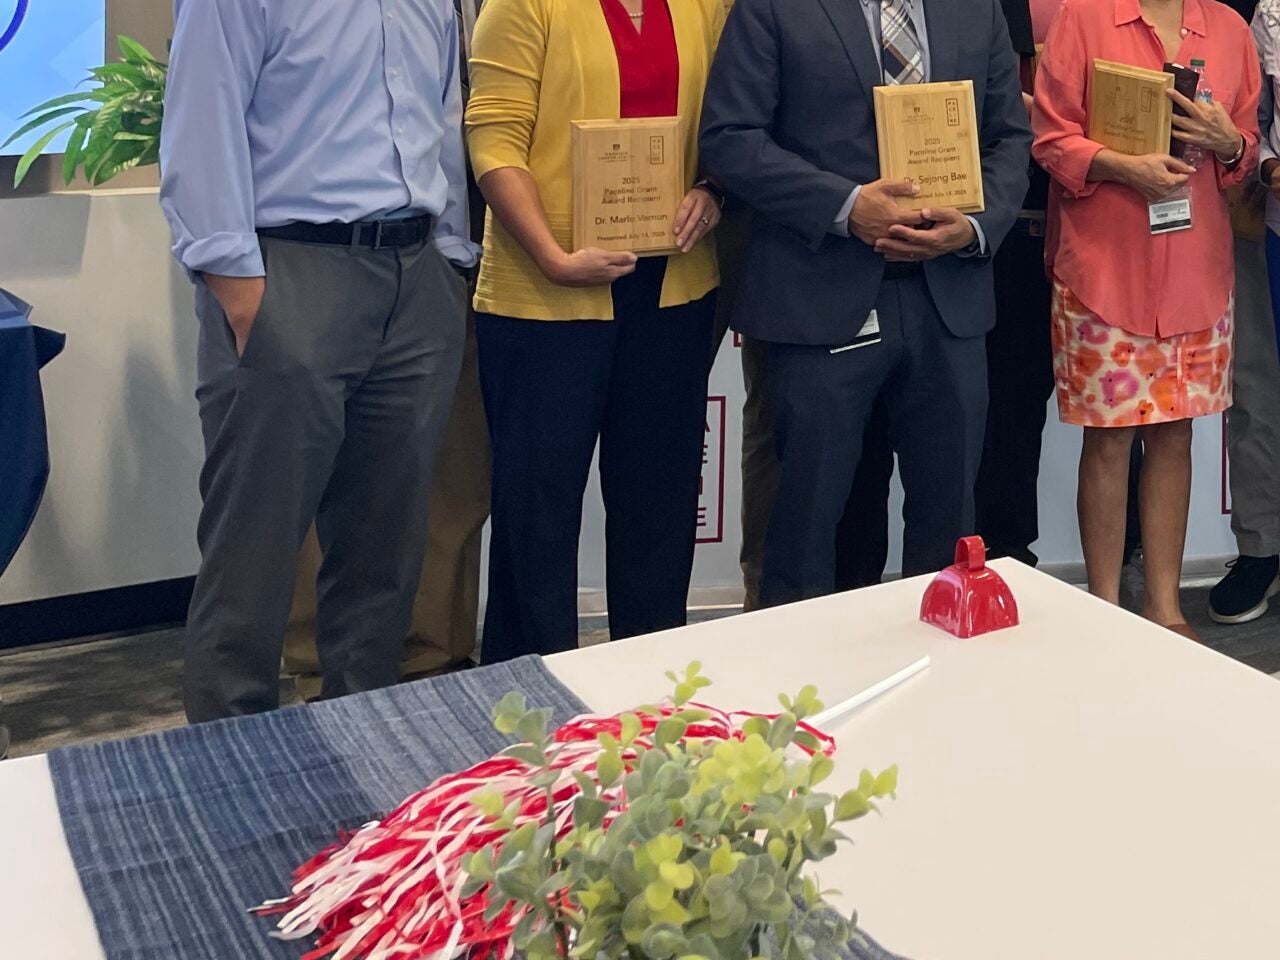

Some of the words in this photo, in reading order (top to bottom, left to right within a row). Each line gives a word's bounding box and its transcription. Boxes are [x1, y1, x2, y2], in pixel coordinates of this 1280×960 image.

[622, 176, 640, 184] 2025
[918, 175, 948, 185] Sejong
[950, 172, 966, 181] Bae
[595, 217, 607, 225] Dr.
